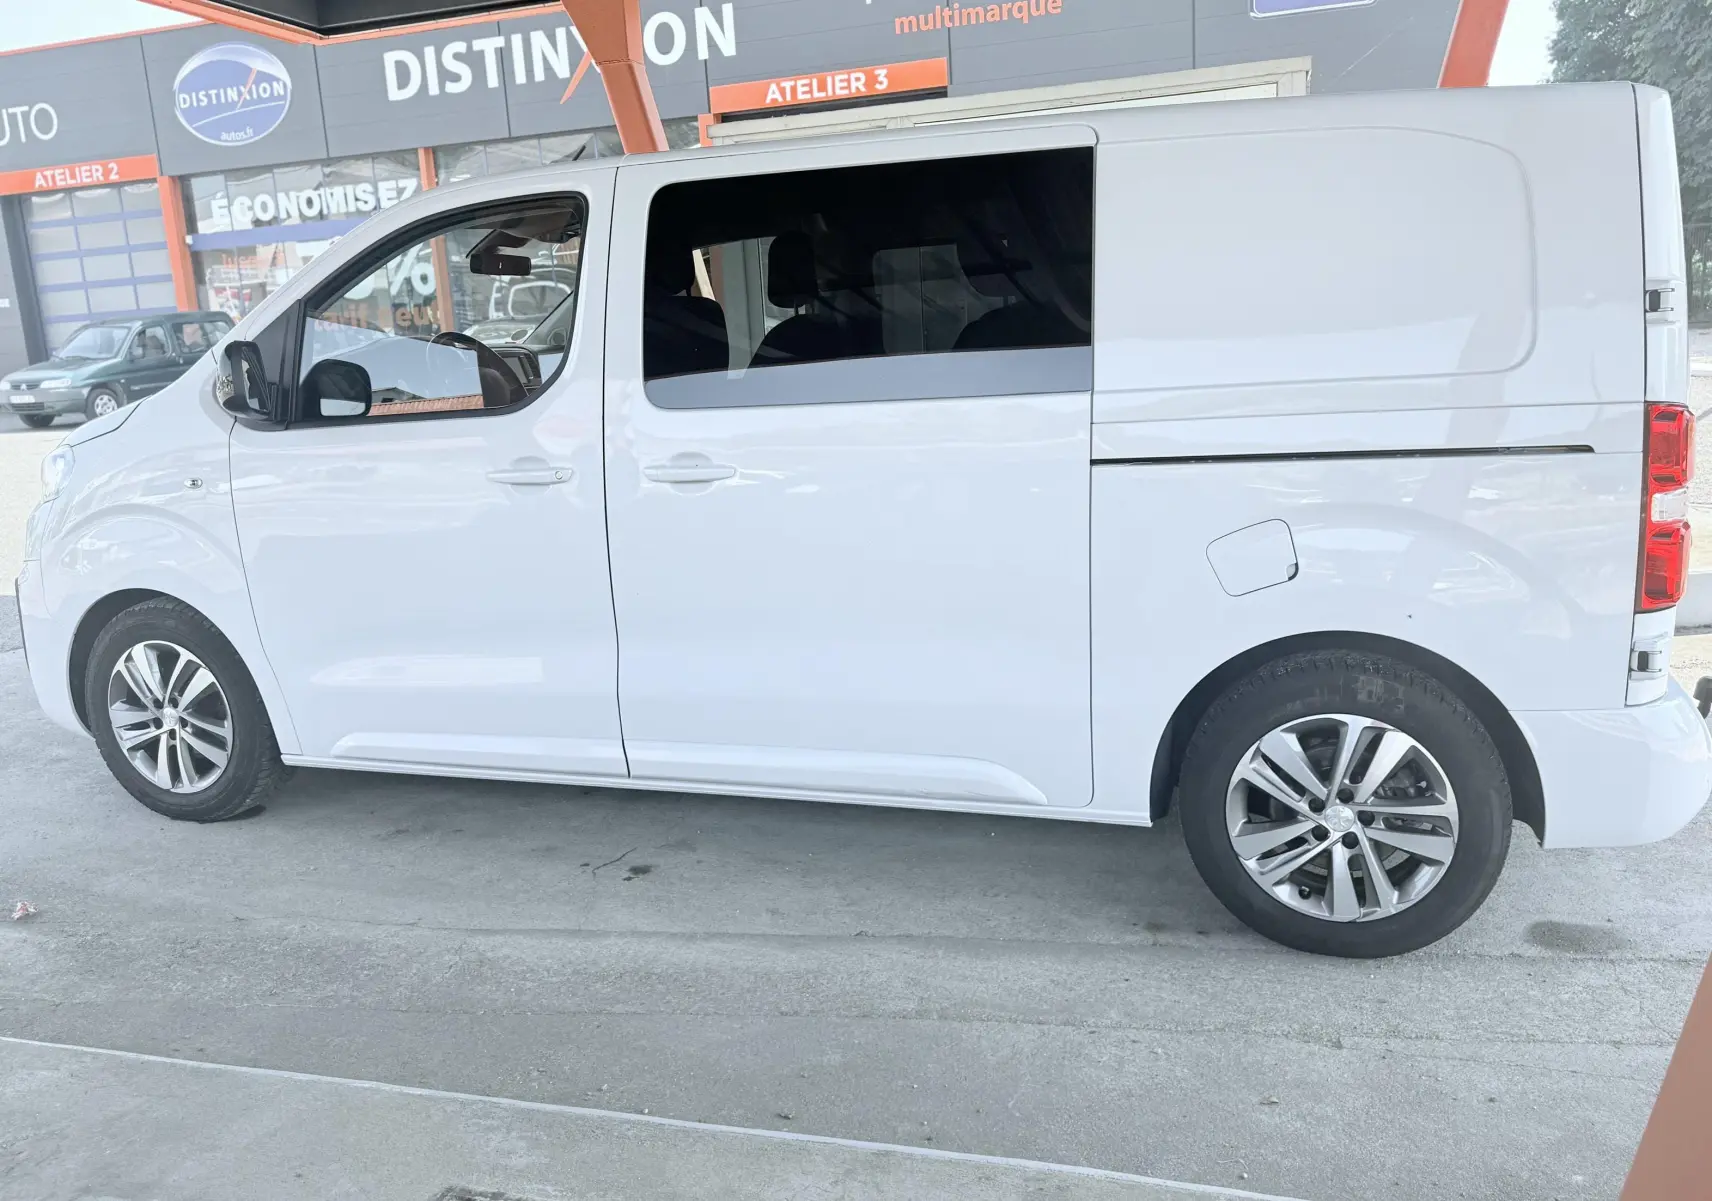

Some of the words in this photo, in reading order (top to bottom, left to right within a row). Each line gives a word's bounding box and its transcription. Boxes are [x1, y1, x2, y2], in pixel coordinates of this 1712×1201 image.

[895, 0, 1063, 34] multimarque
[383, 3, 737, 104] DISTINON
[179, 80, 285, 109] DISTINXION
[765, 72, 867, 104] ATELIER
[874, 69, 889, 91] 3
[221, 126, 254, 141] autos.fr
[34, 164, 105, 189] ATELIER
[107, 162, 119, 180] 2
